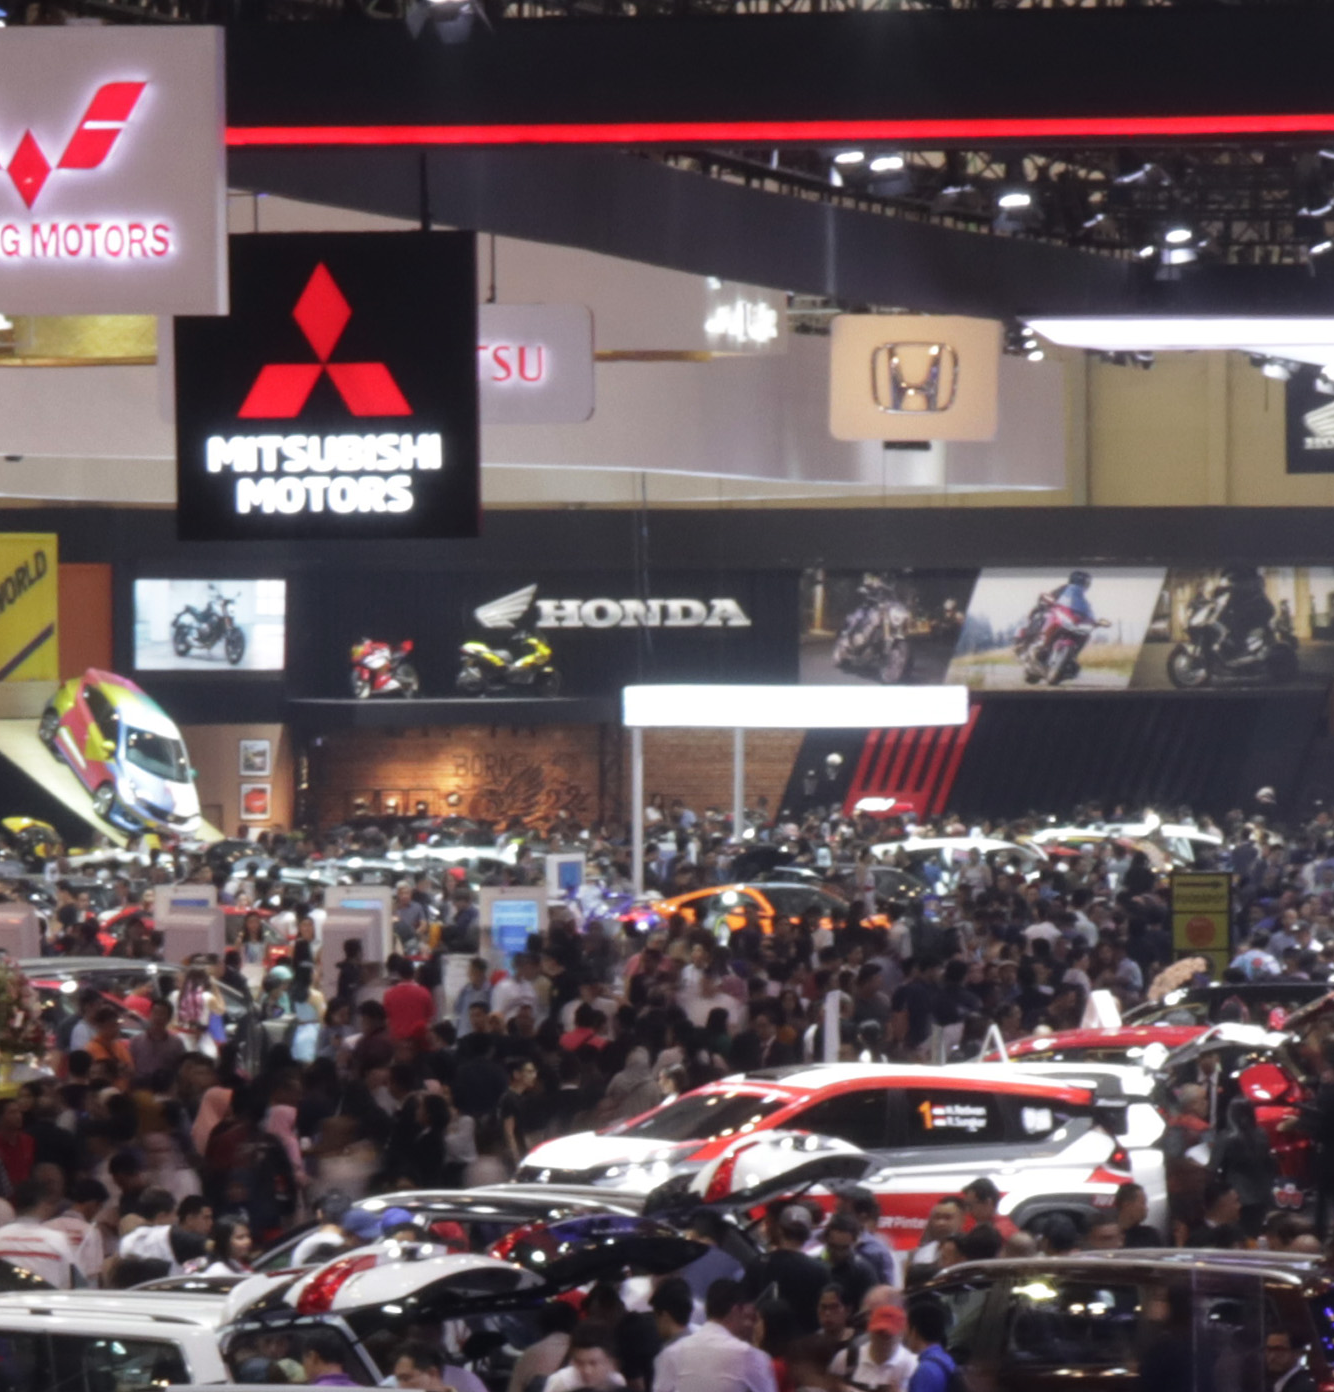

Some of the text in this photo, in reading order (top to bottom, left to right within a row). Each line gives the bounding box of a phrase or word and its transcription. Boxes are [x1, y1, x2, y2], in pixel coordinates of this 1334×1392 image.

[31, 223, 171, 258] MOTORS
[207, 433, 441, 473] MITSUBISHI
[237, 476, 413, 514] MOTORS
[536, 598, 751, 628] HONDA
[918, 1100, 933, 1130] 1
